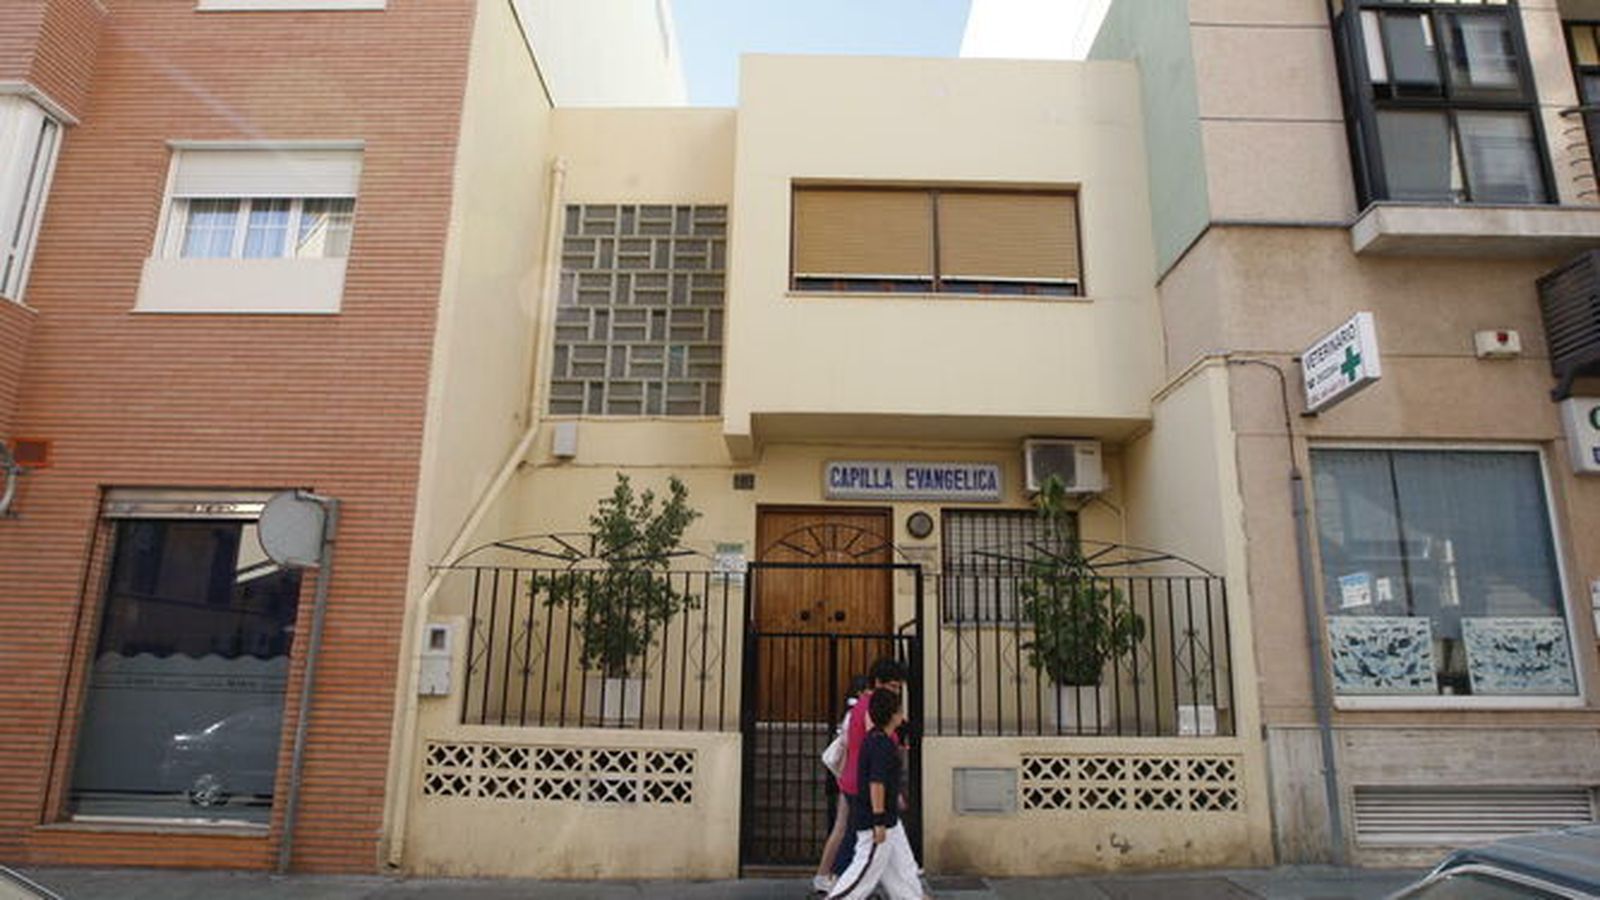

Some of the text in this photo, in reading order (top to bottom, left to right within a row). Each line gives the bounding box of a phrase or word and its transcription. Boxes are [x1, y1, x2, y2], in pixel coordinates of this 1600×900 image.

[1304, 322, 1355, 370] VETERINARIO
[829, 465, 997, 491] CAPILLA EVANGELICA
